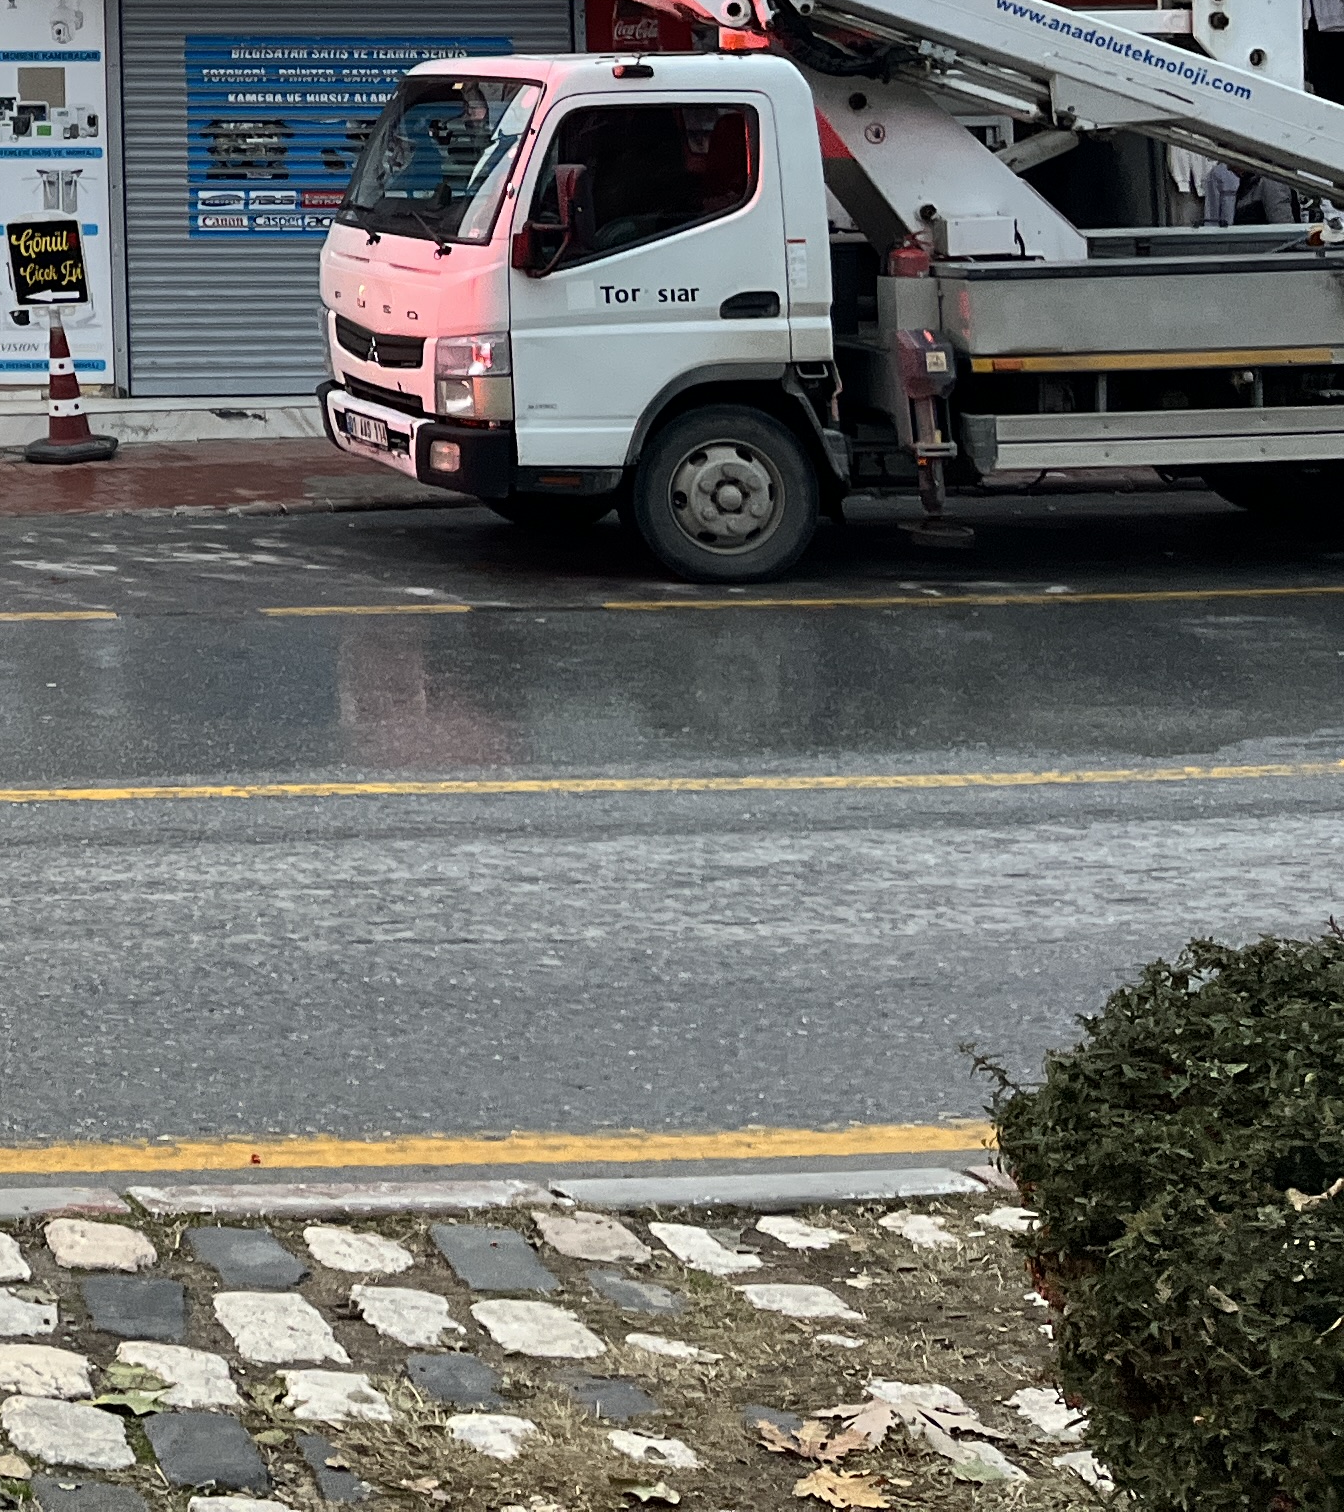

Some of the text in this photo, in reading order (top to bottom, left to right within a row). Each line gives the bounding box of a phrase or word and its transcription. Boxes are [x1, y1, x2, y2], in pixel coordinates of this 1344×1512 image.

[11, 228, 70, 258] Gönül
[20, 260, 83, 287] Çiçek Evi
[334, 290, 419, 321] FUSO
